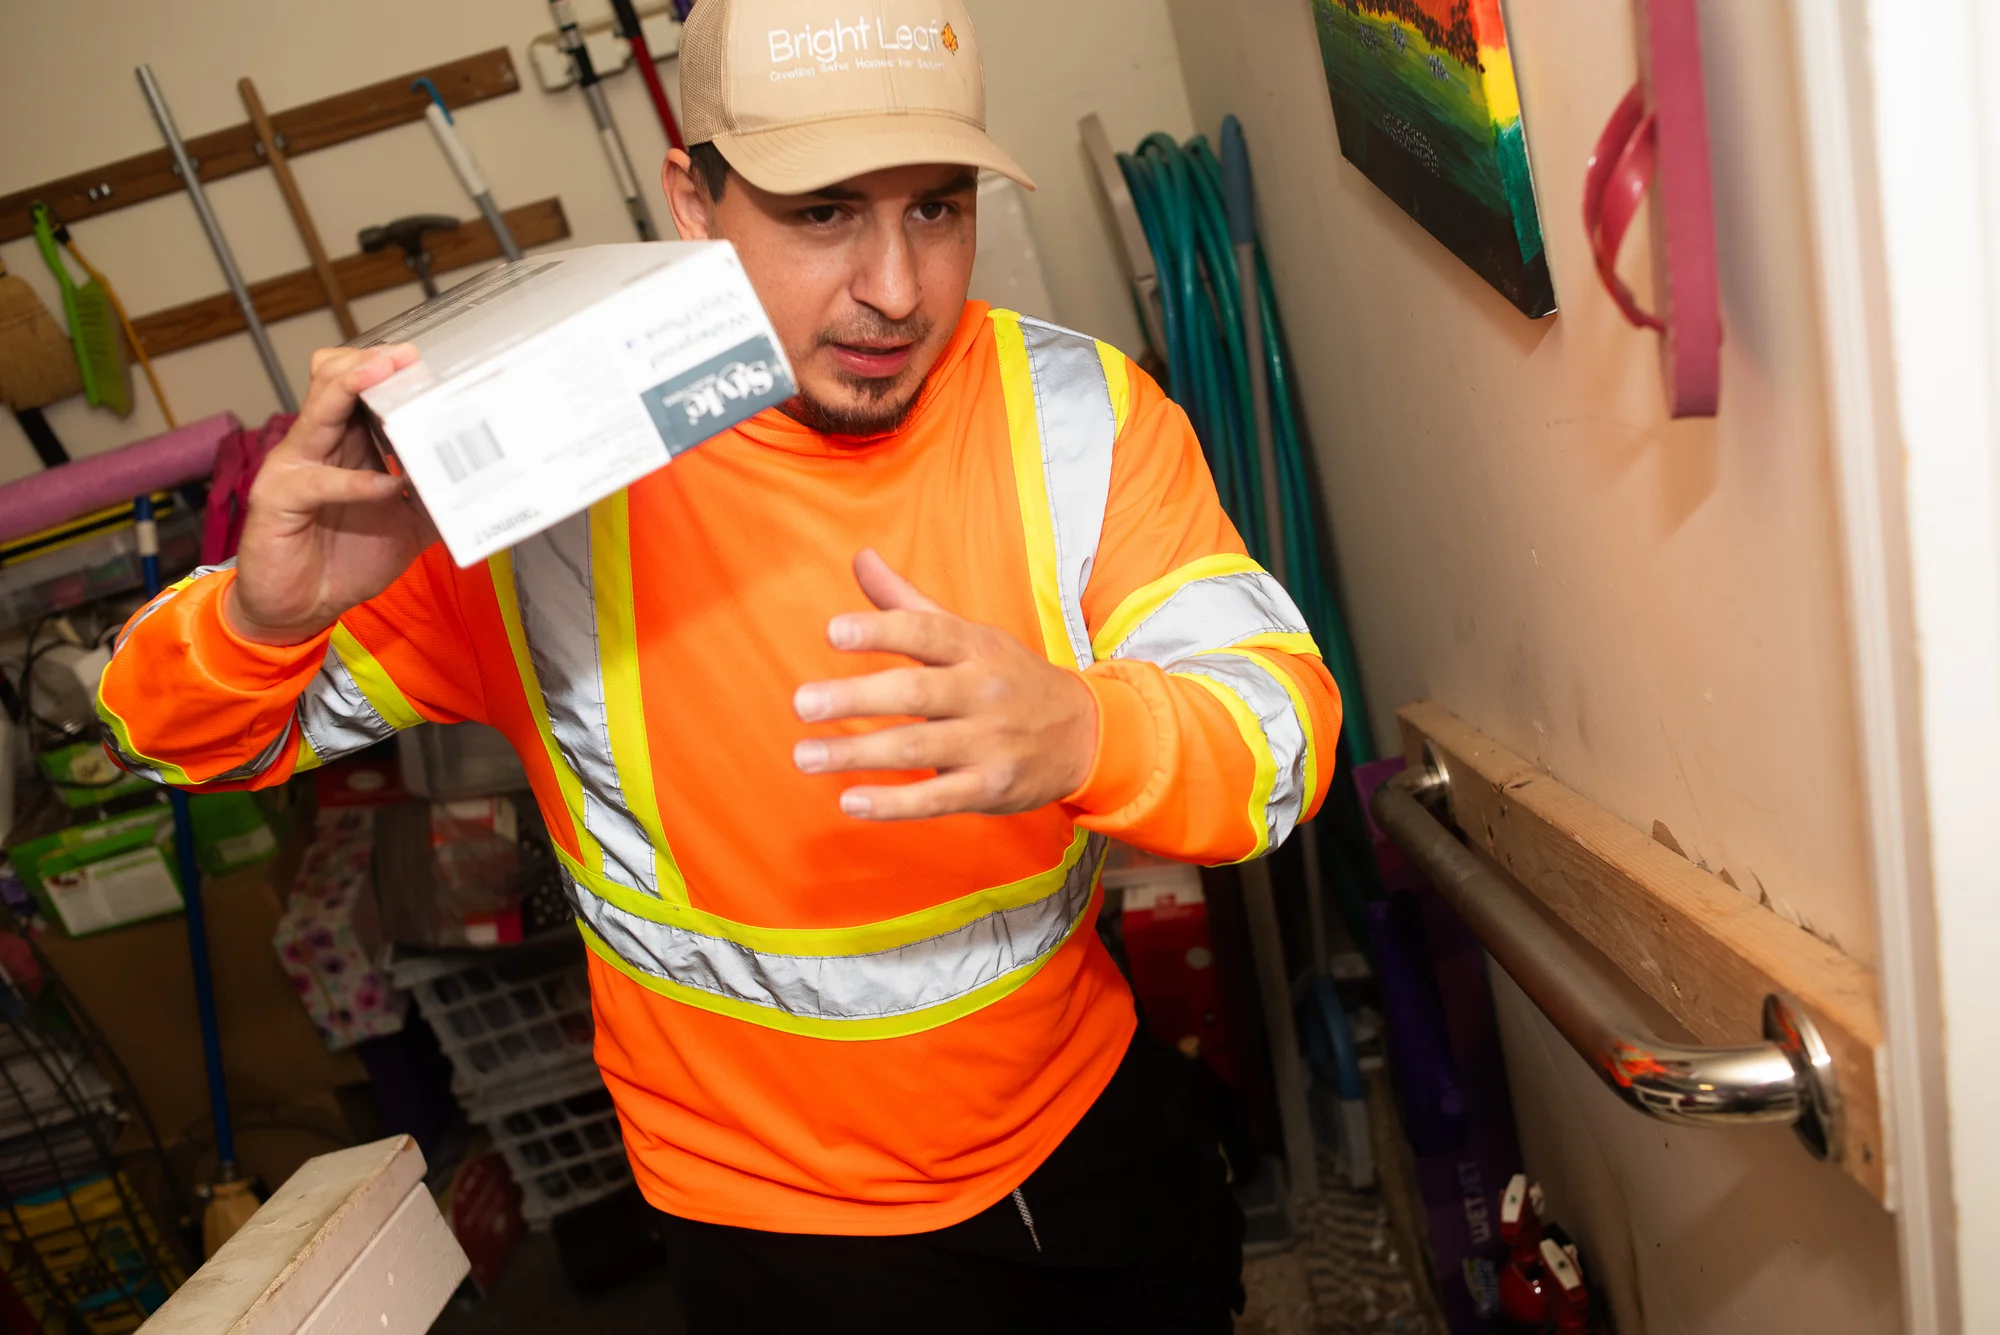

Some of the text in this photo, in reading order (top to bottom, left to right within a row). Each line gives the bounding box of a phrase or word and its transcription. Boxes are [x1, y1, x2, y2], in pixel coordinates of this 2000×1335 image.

[768, 16, 938, 63] Bright Leaf
[770, 66, 815, 82] Creating
[820, 61, 849, 74] Safer
[855, 57, 895, 69] Homes
[899, 57, 913, 68] for
[648, 311, 752, 370] Waterproof
[680, 360, 773, 425] Style
